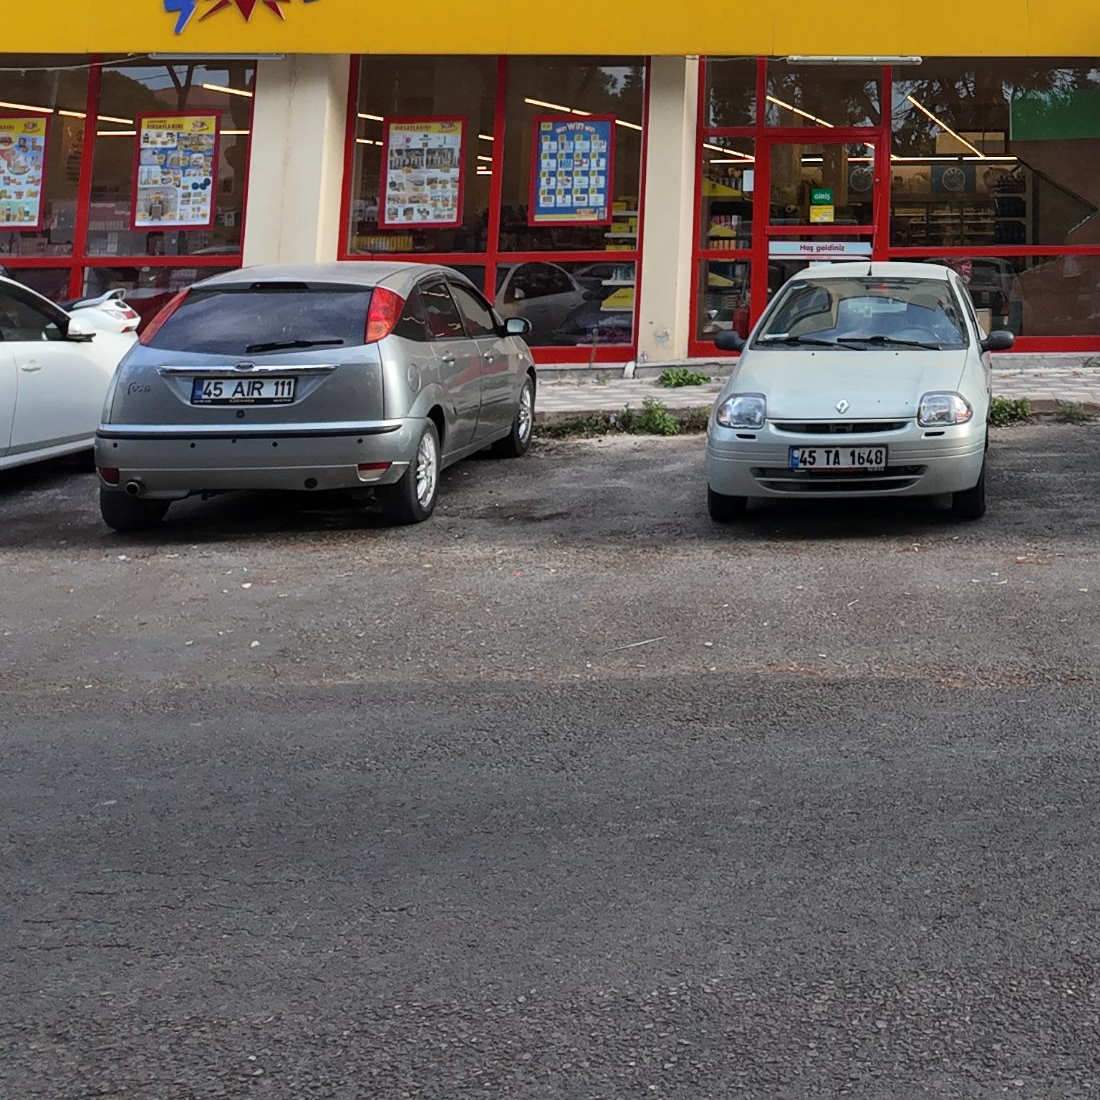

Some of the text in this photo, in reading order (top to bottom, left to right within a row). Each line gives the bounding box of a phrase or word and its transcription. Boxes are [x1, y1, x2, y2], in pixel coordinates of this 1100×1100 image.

[816, 244, 845, 252] geldiniz
[203, 380, 292, 398] 45 AIR 111
[800, 449, 883, 466] 45 TA 1648
